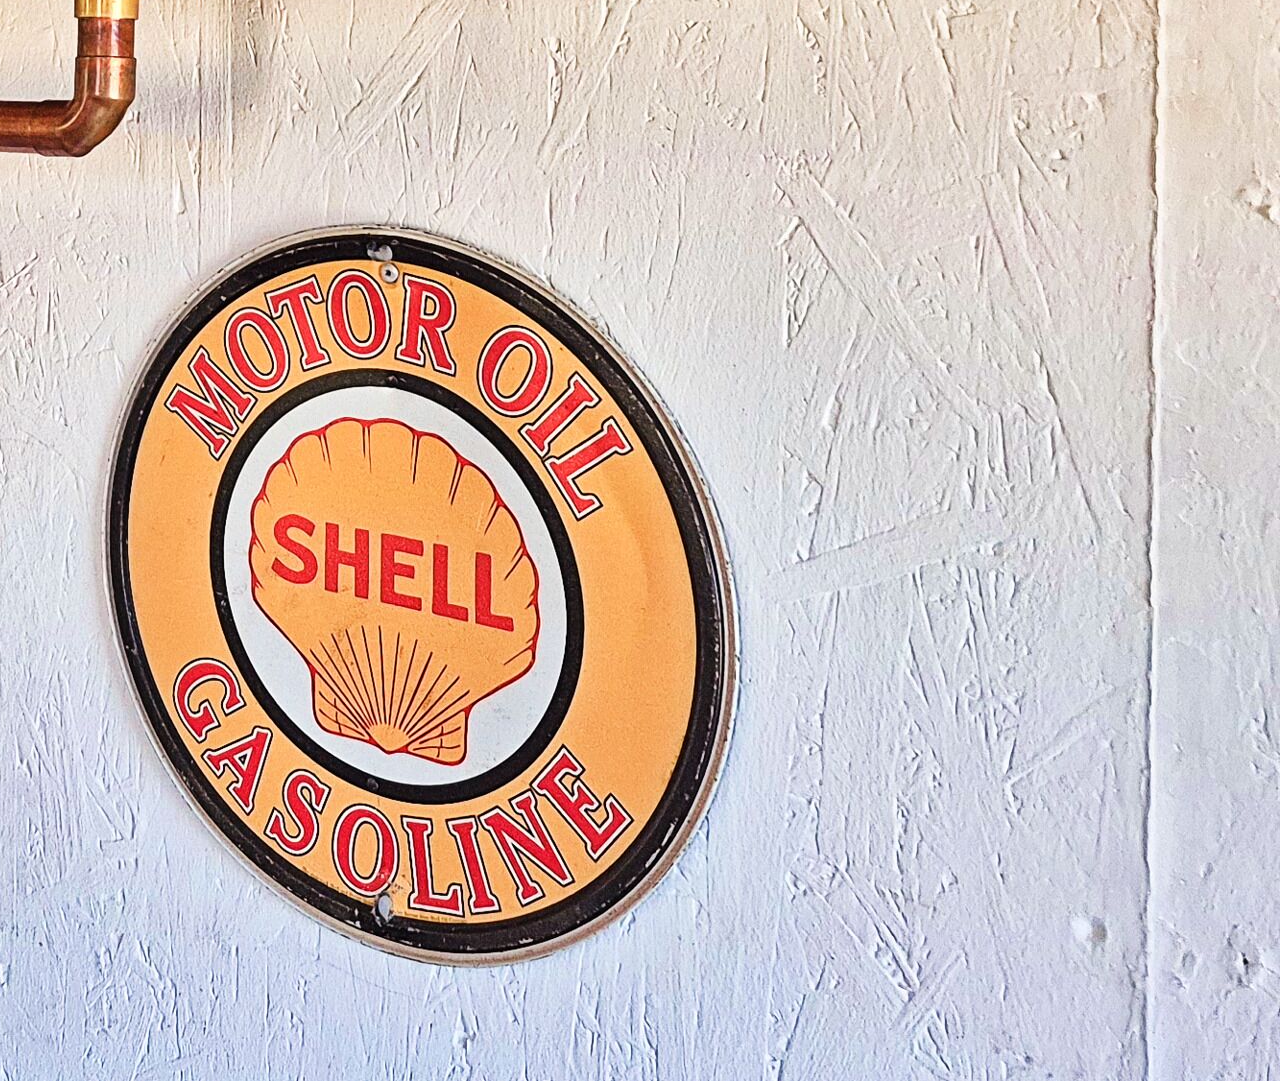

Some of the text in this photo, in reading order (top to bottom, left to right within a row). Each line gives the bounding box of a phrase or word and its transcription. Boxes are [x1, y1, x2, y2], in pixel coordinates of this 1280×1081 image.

[165, 269, 635, 520] MOTOR OIL
[271, 513, 515, 632] SHELL
[172, 657, 635, 918] GASOLINE
